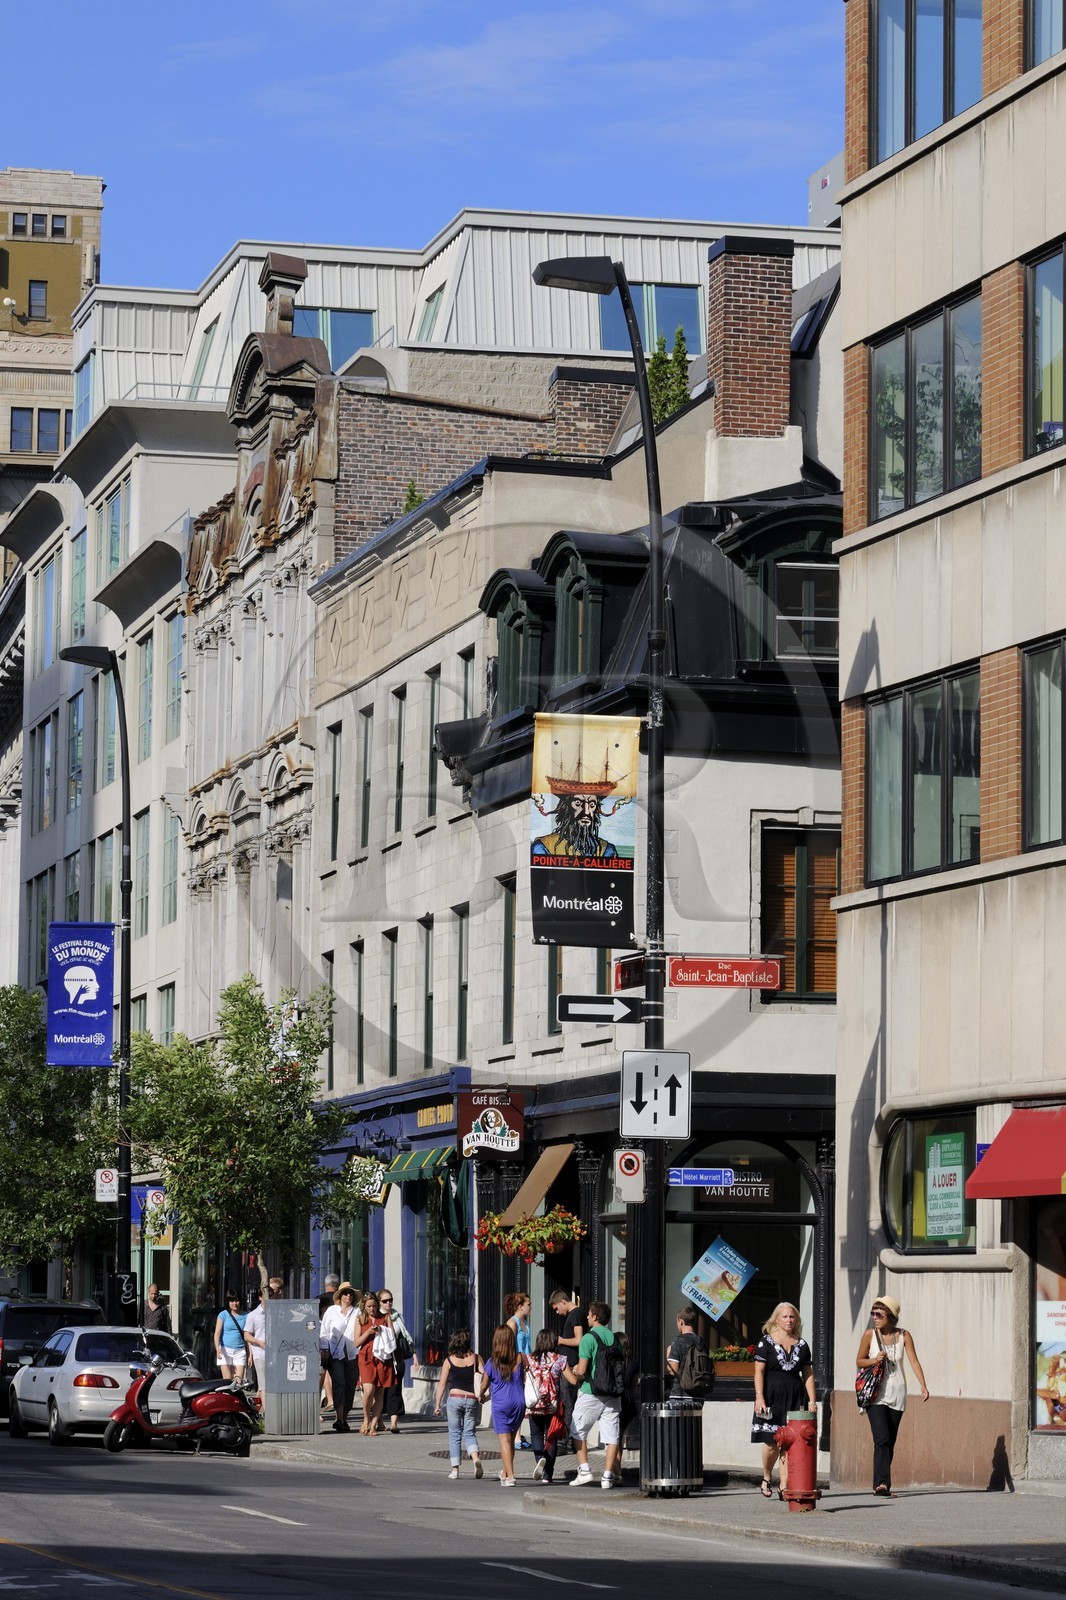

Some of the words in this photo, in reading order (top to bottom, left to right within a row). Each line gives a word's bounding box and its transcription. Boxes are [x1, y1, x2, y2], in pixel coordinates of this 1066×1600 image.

[533, 855, 631, 869] POINTE-À-CALLIÈRE
[543, 895, 603, 910] Montréal
[52, 946, 60, 954] LE
[59, 940, 82, 952] FESTIVAL
[95, 942, 111, 953] FILMS
[55, 949, 69, 962] DU
[71, 947, 106, 962] MONDE
[676, 969, 773, 987] Saint-Jean-Baptiste
[54, 1034, 93, 1044] Montréal
[472, 1095, 487, 1105] CAFÉ
[466, 1134, 481, 1145] VAN
[484, 1134, 516, 1147] HOUTTE
[684, 1173, 698, 1181] Hôtel
[734, 1171, 762, 1182] BISTRO
[938, 1173, 957, 1187] LOUER
[704, 1187, 725, 1195] VAN
[730, 1187, 770, 1197] HOUTTE
